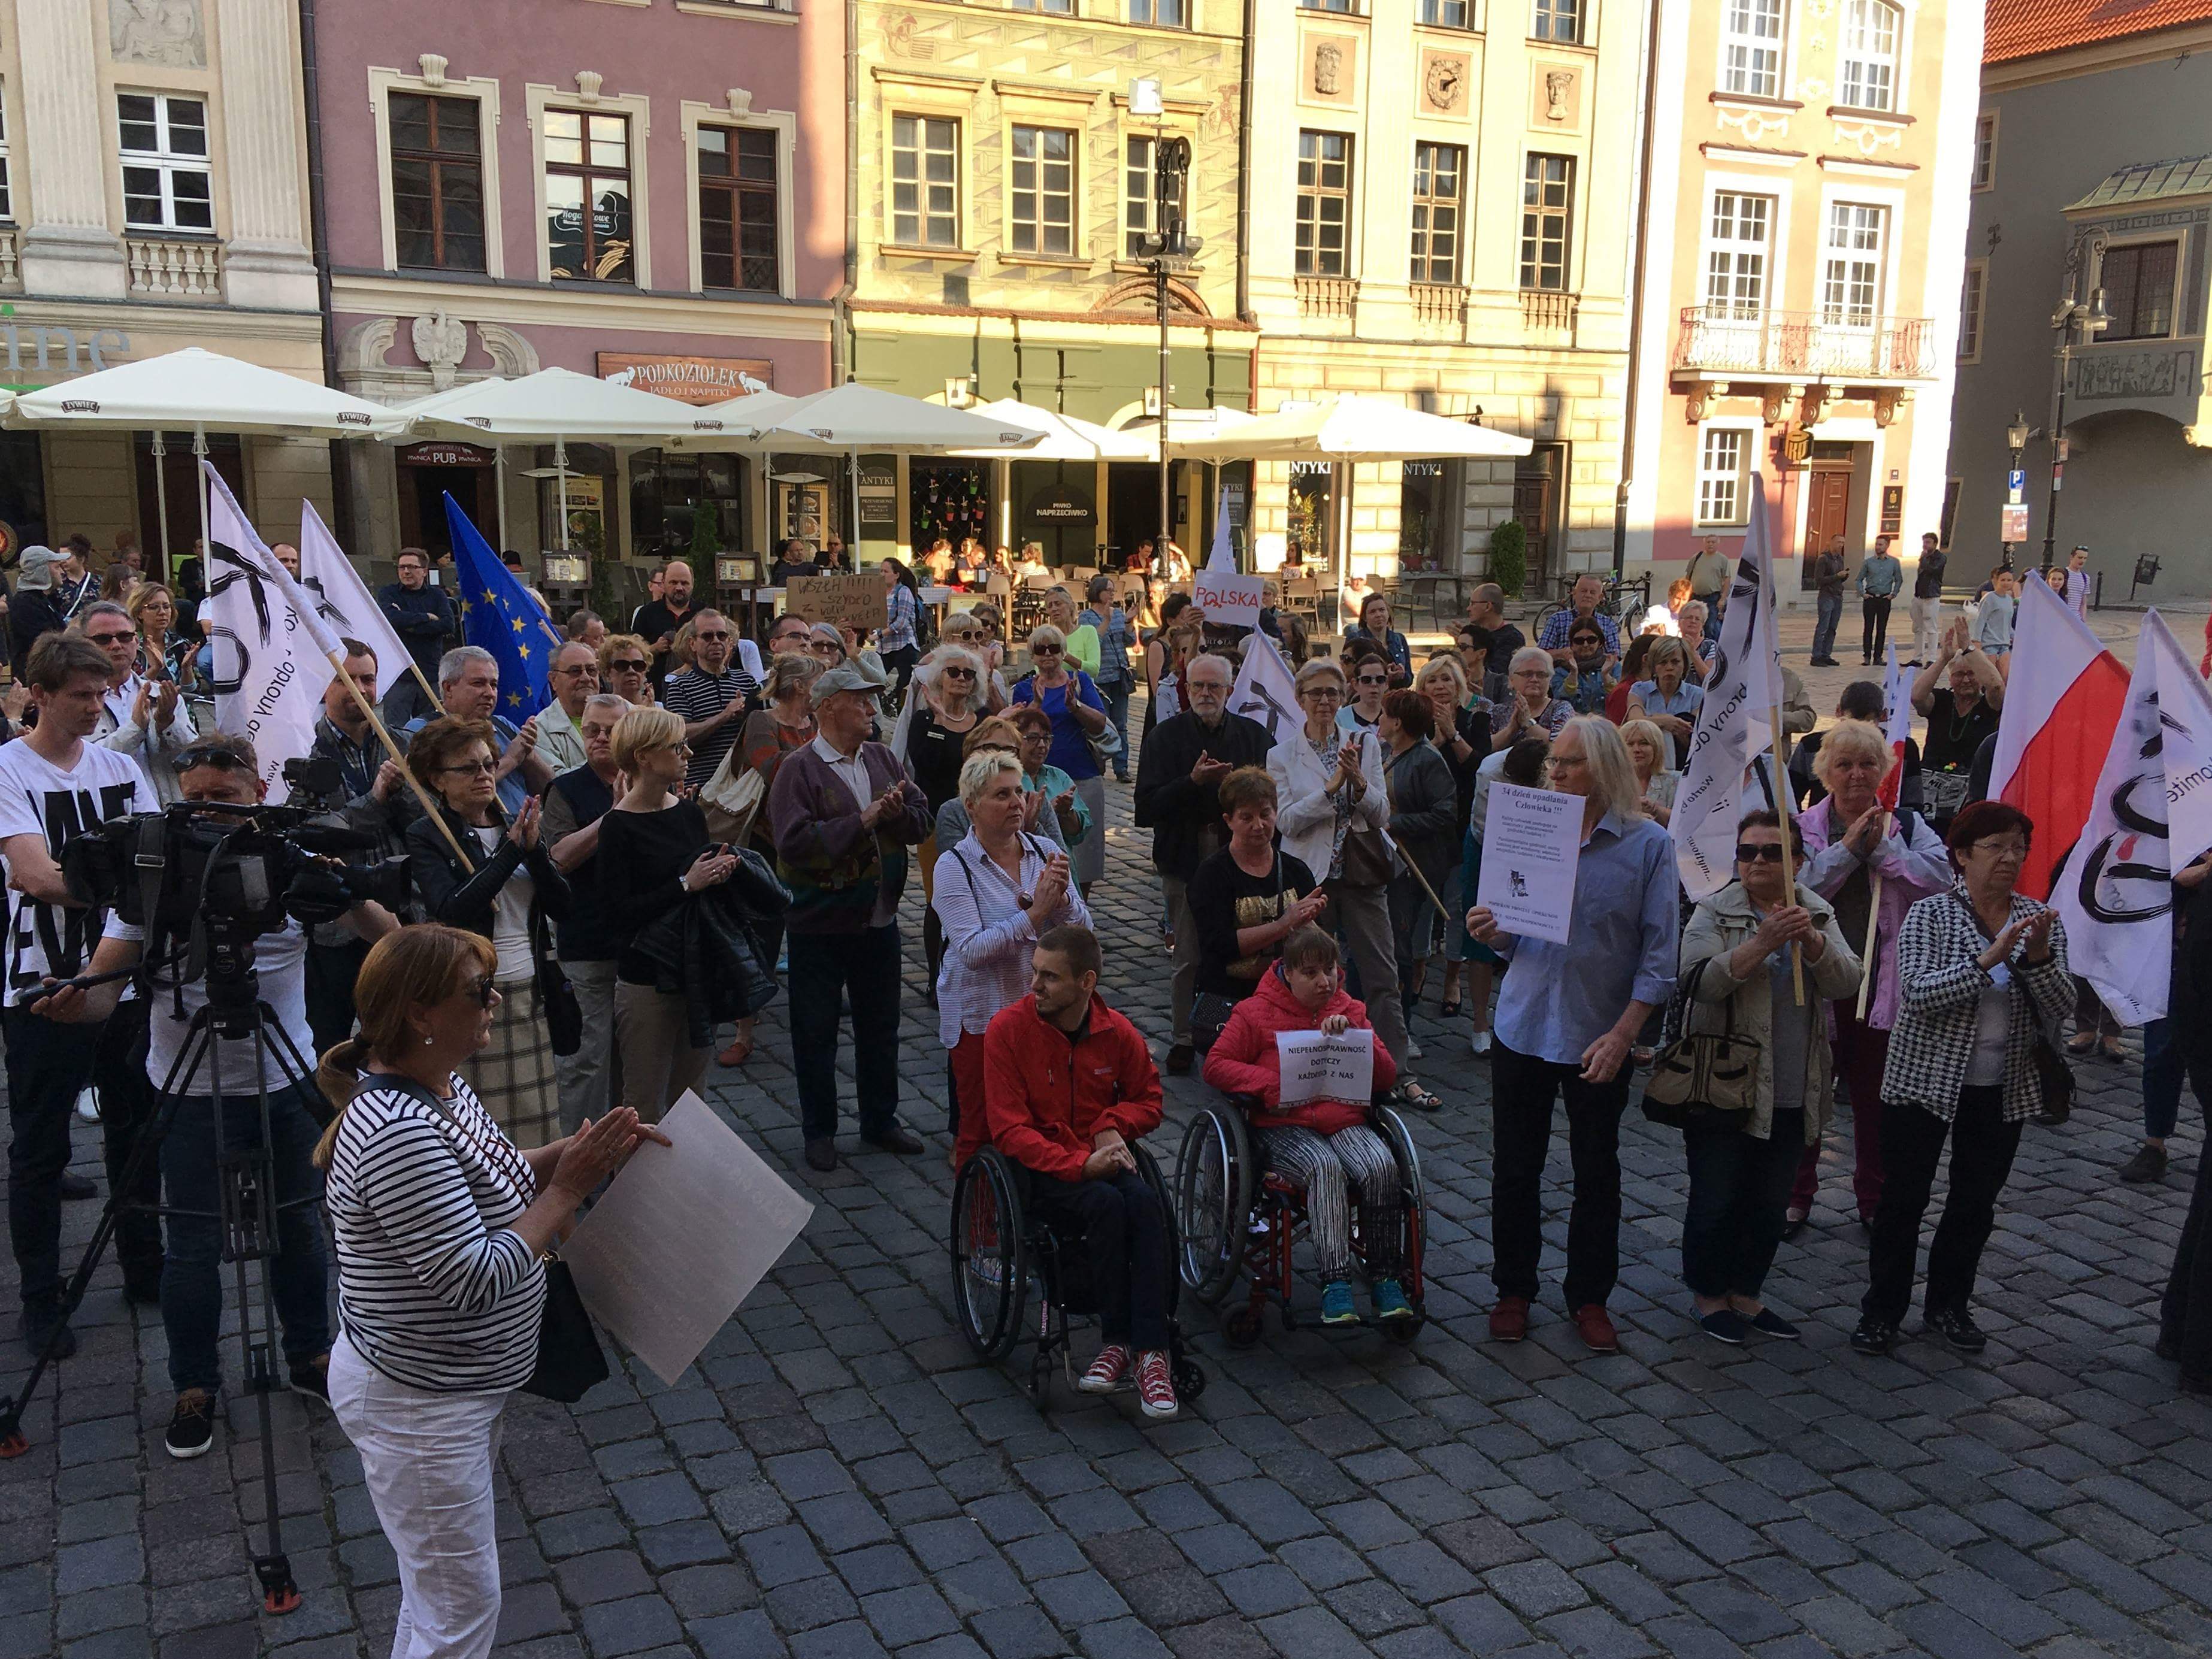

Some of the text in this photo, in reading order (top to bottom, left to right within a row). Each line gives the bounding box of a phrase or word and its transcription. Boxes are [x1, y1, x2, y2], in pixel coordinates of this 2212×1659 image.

[637, 364, 739, 388] PODKOZIOŁEK
[650, 386, 682, 395] JADŁO
[689, 387, 730, 396] NAPITKI
[433, 452, 456, 464] PUB
[1290, 461, 1331, 474] NTYKI
[1404, 464, 1442, 476] NTYKI
[861, 476, 894, 485] ANTYKI
[1196, 586, 1258, 608] POLSKA
[1501, 787, 1511, 796] 34
[1512, 789, 1531, 799] dzień
[1288, 1045, 1366, 1054] NIEPEŁNOSPRAWNOŚĆ
[1338, 1071, 1354, 1080] NAS
